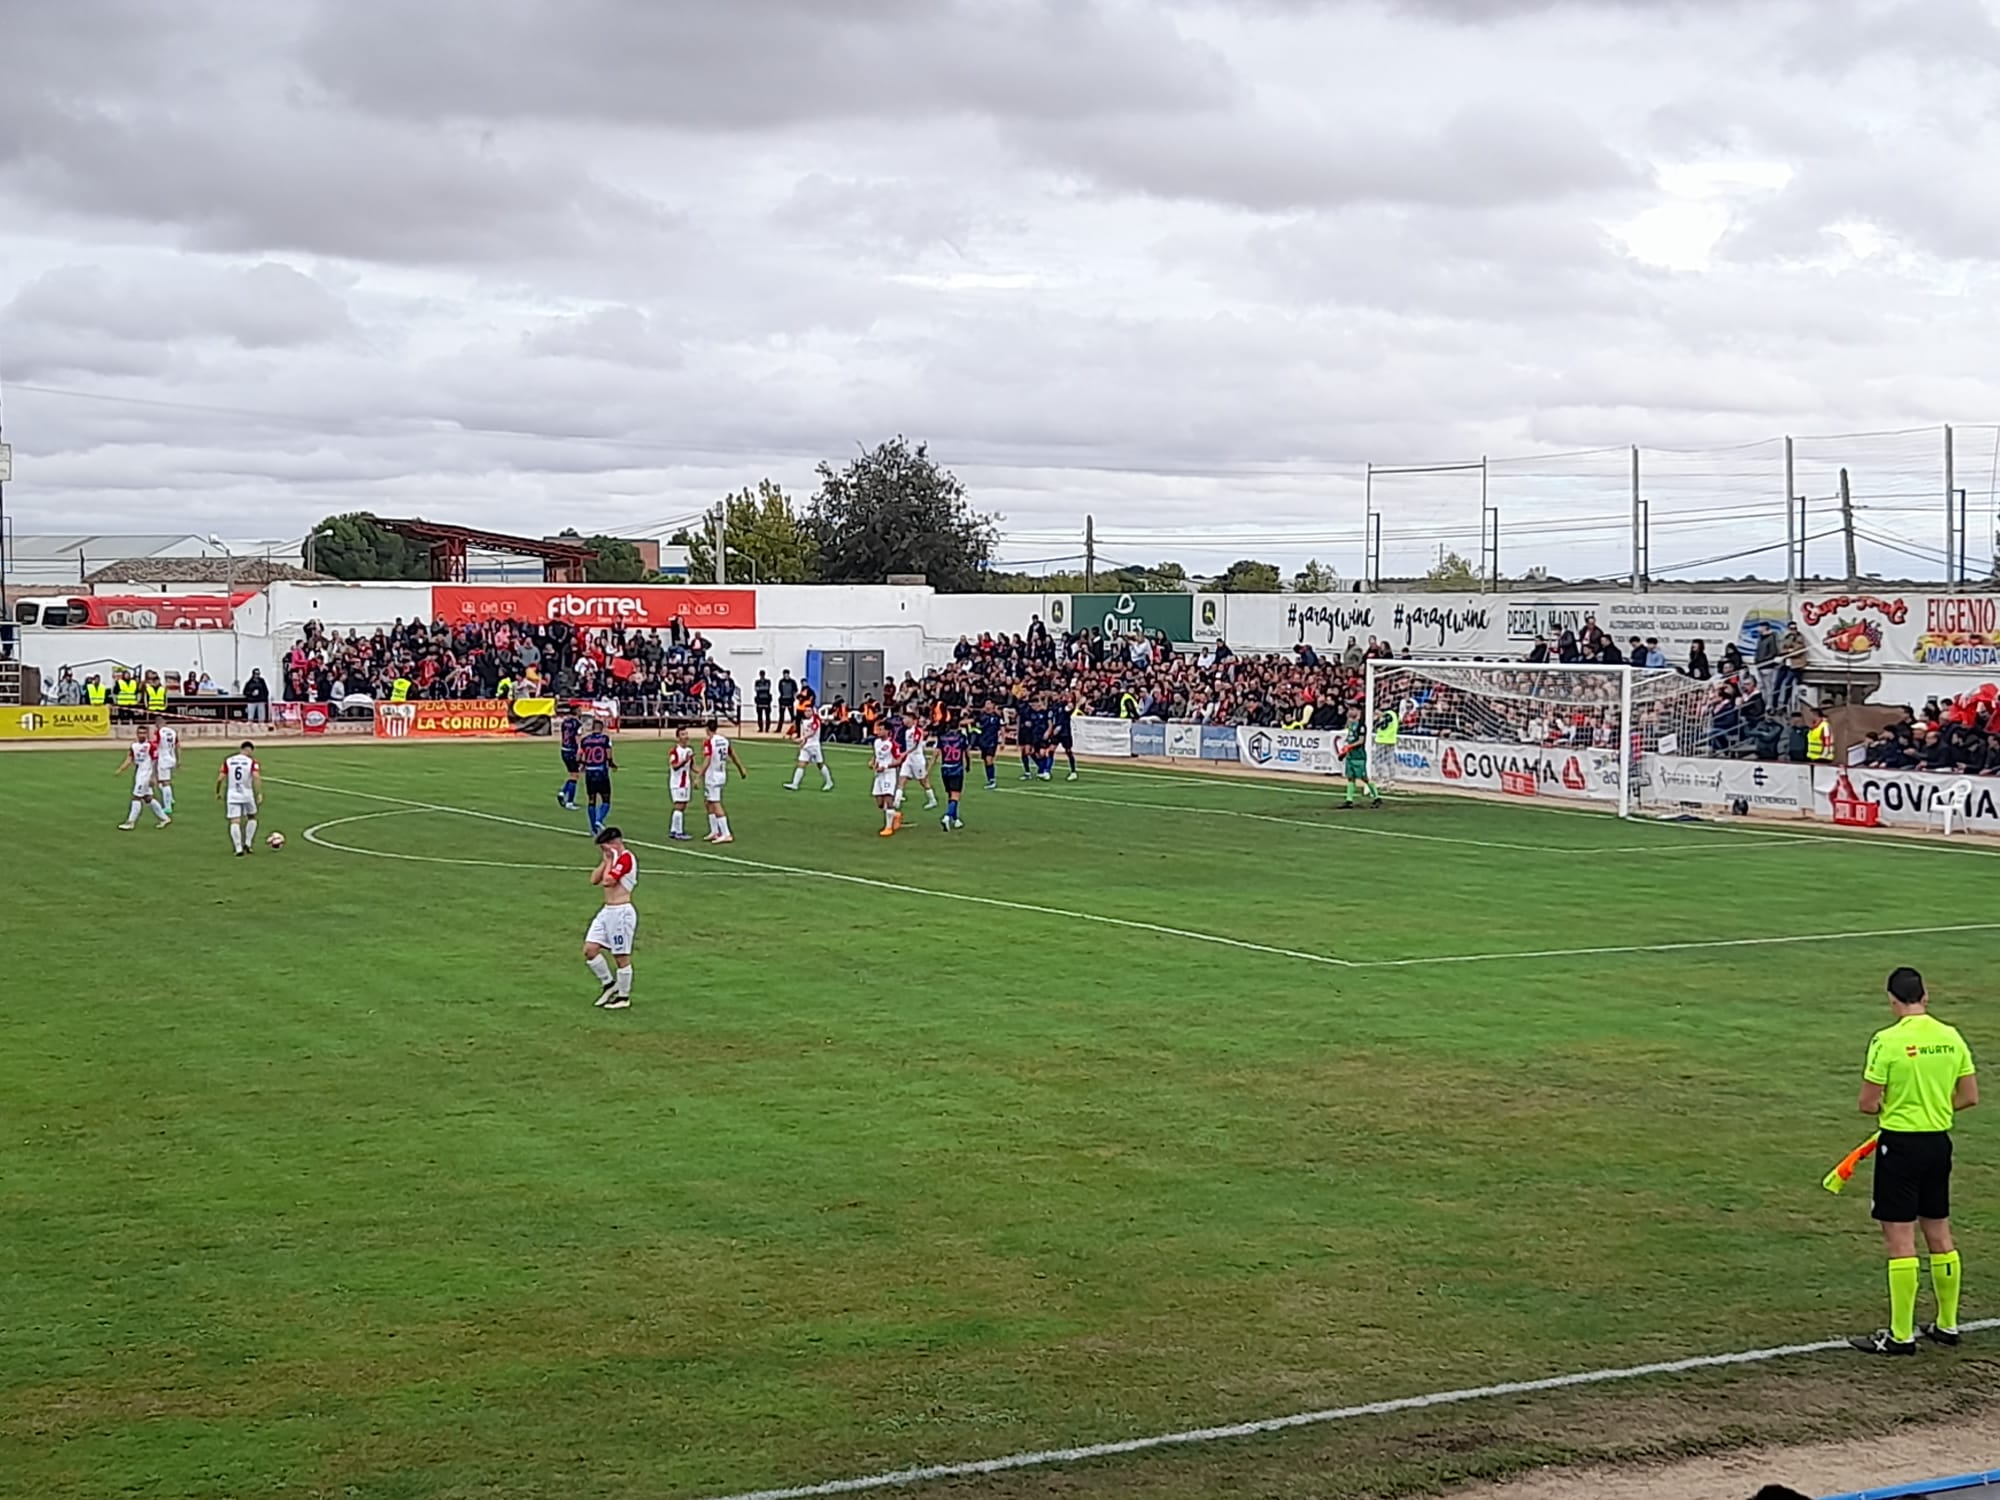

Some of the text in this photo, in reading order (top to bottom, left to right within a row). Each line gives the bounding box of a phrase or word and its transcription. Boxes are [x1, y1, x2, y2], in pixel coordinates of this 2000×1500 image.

[1287, 599, 1376, 644] #garagewine
[1393, 599, 1492, 647] #garagewine
[1507, 610, 1538, 634] PEREA
[1926, 598, 1997, 633] EUGENIO
[1927, 648, 1998, 664] MAYORISTA
[449, 701, 509, 712] SEVILLISTA
[417, 717, 510, 730] LA CORRIDA
[586, 746, 605, 763] 20
[944, 745, 961, 763] 26
[235, 766, 242, 781] 6
[1863, 780, 1998, 820] COVAA
[613, 935, 624, 945] 10
